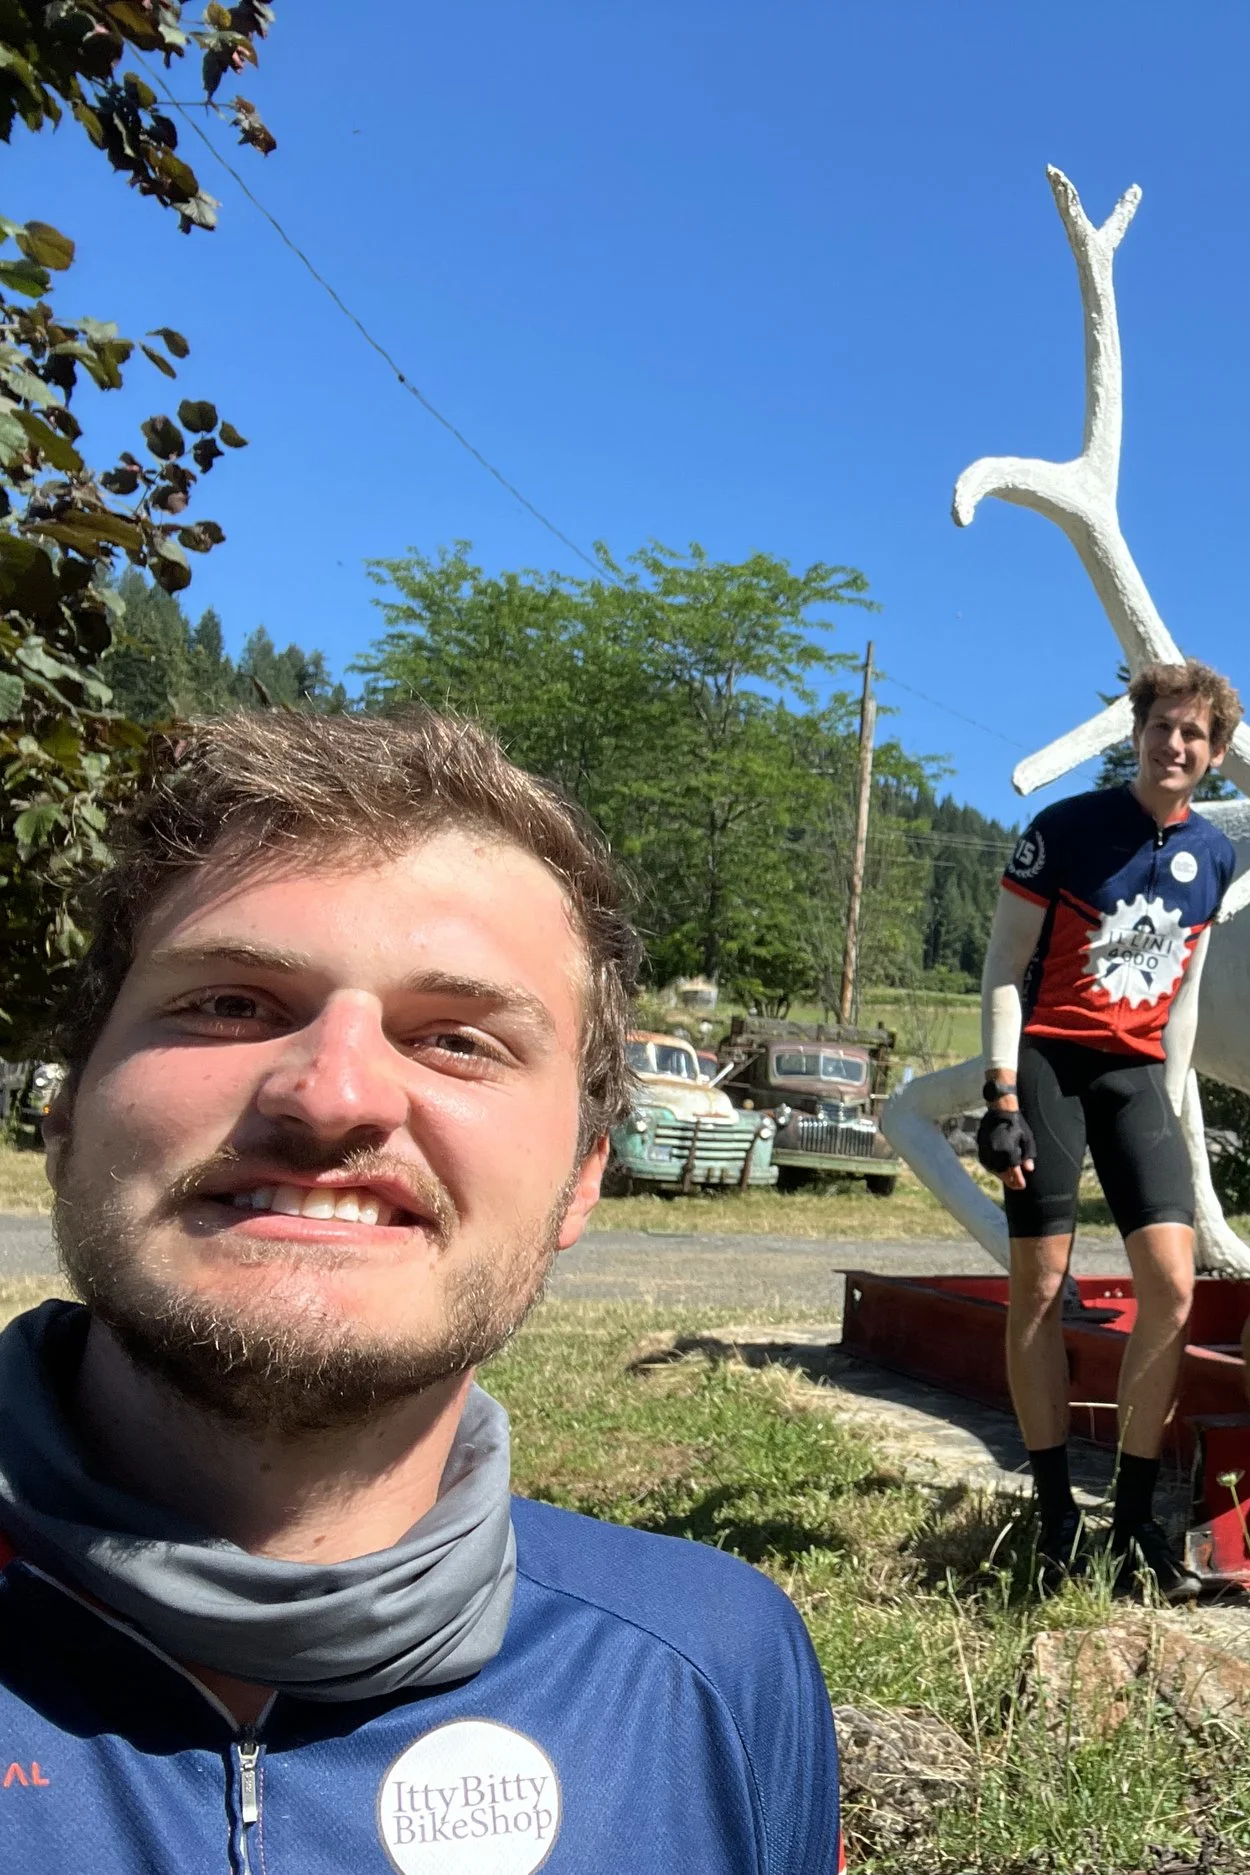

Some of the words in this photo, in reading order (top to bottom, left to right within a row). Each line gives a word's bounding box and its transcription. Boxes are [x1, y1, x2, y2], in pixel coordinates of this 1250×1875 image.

[1015, 839, 1035, 867] 15
[1109, 931, 1172, 954] ILLINI
[1108, 948, 1159, 970] 4000
[392, 1773, 550, 1822] IttyBitty
[393, 1804, 552, 1845] BikeShop
